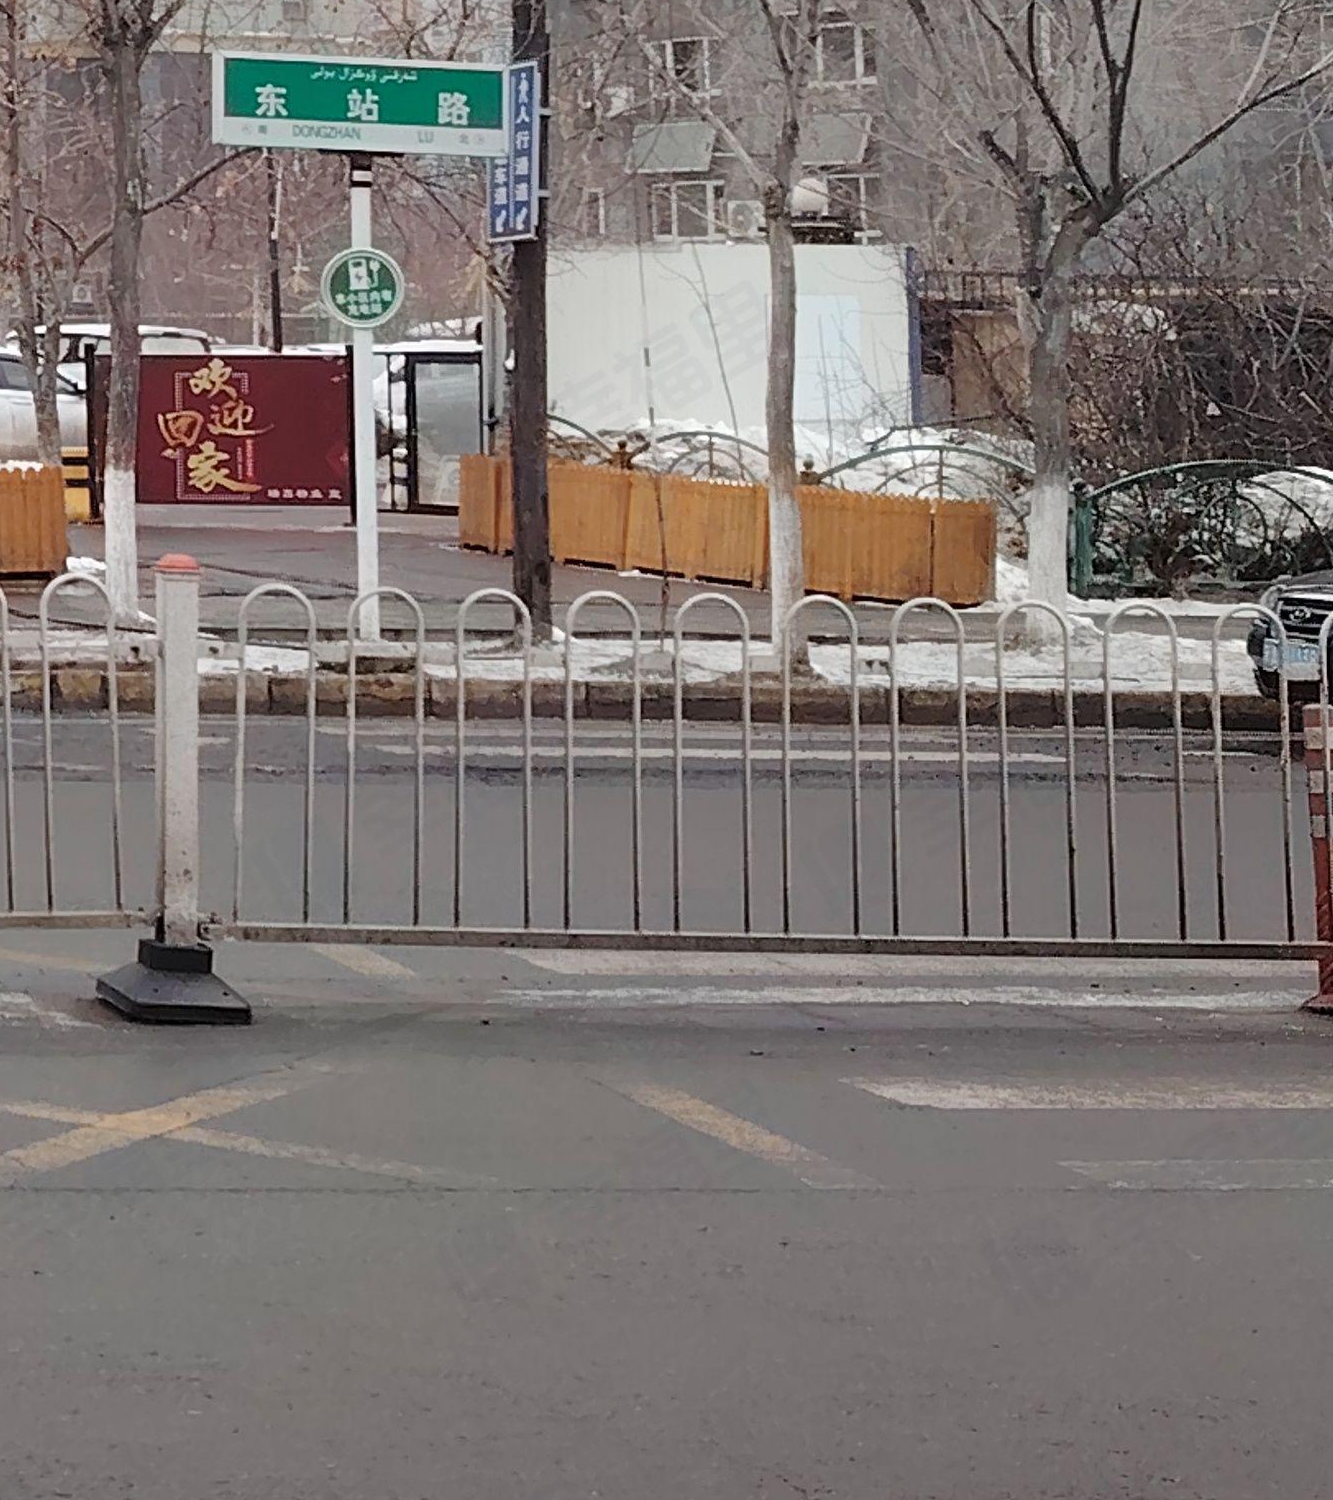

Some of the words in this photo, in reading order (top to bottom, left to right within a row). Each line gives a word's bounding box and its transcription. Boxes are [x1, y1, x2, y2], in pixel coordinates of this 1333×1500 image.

[255, 83, 470, 126] 东站路
[292, 124, 362, 141] DONGZHAN
[417, 130, 435, 144] LU
